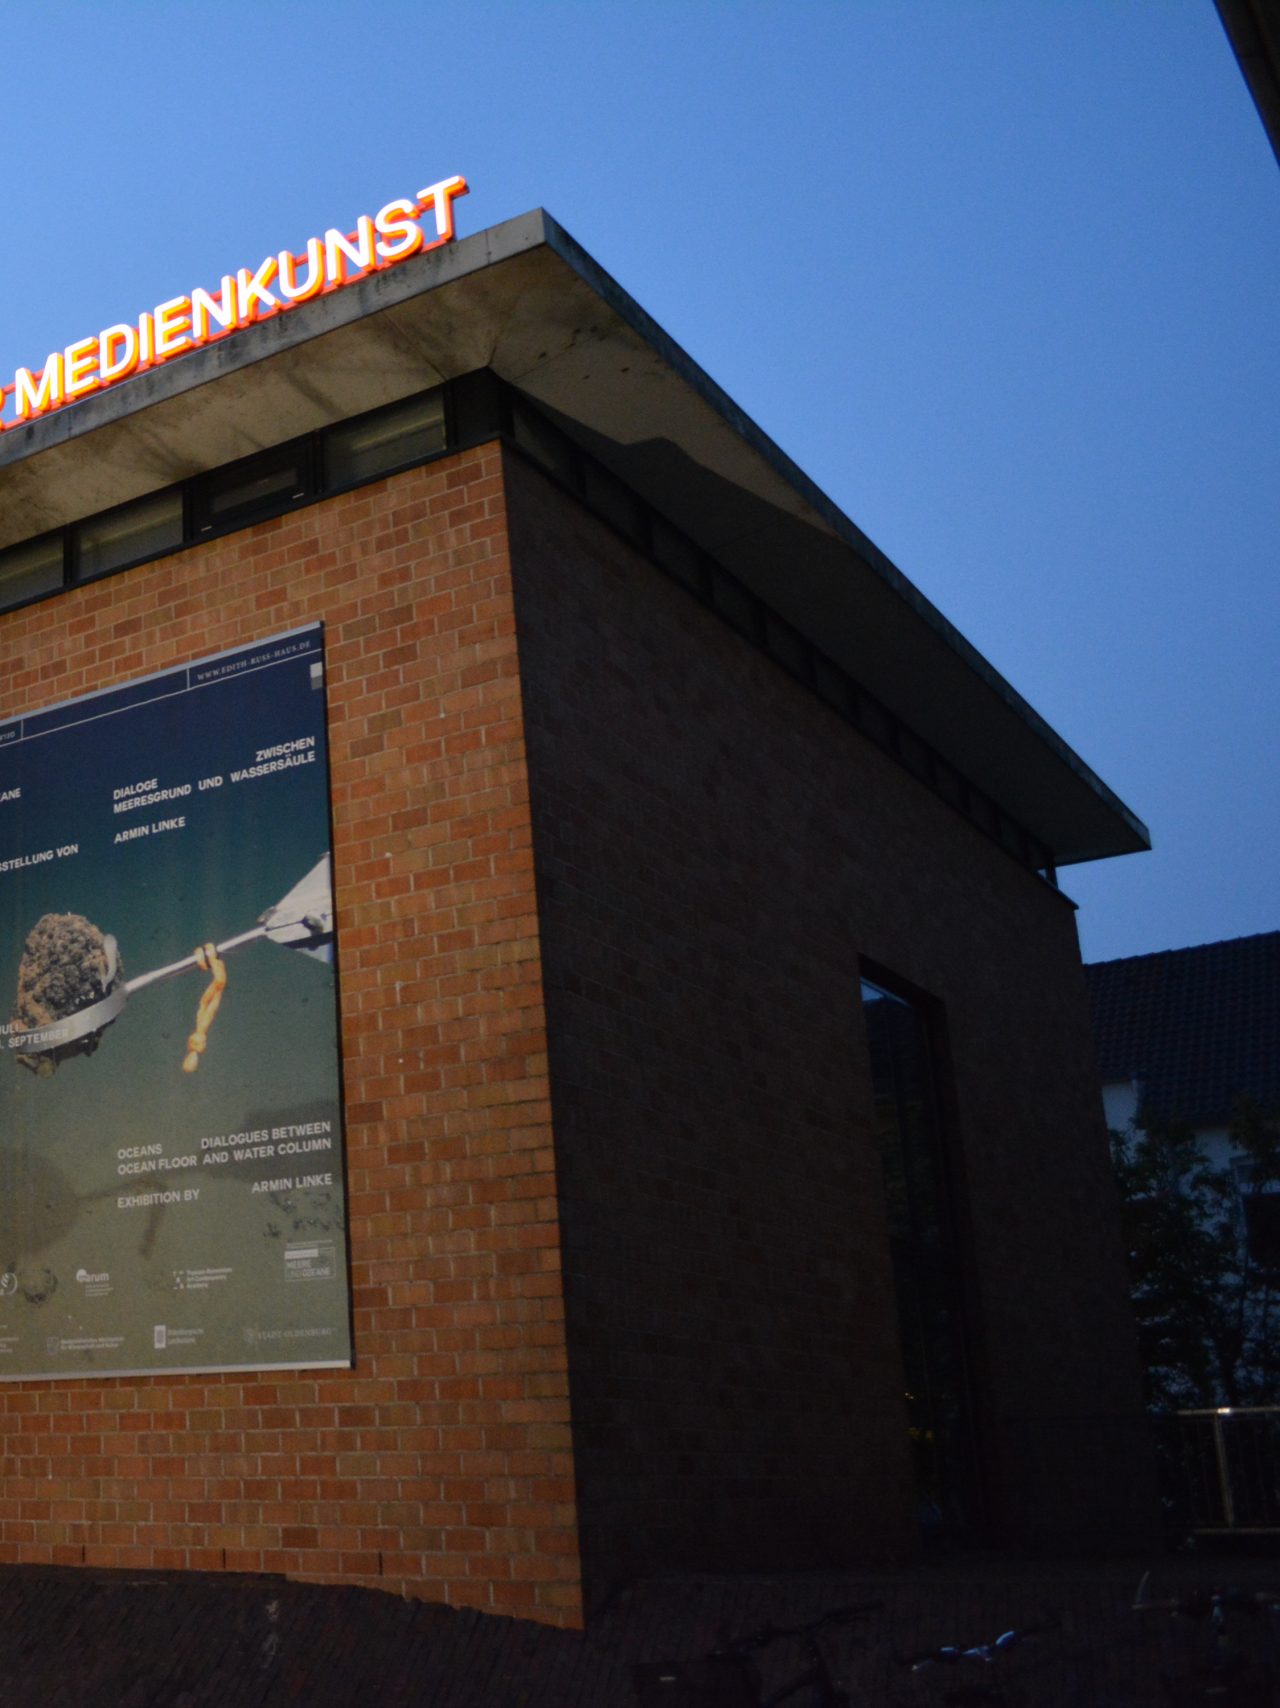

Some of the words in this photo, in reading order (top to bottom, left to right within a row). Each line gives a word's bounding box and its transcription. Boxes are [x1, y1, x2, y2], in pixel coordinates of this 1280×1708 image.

[14, 175, 469, 416] MEDIENKUNST
[255, 736, 316, 762] ZWISCHEN
[113, 784, 192, 814] MEERESGRUND
[198, 775, 224, 791] UND
[230, 750, 316, 783] WASSERSÄULE
[113, 778, 158, 800] DIALOGE
[114, 822, 150, 844] ARMIN
[151, 816, 186, 836] LINKE
[56, 843, 79, 858] VON
[200, 1129, 269, 1150] DIALOGUES
[271, 1120, 331, 1141] BETWEEN
[117, 1143, 163, 1160] OCEANS
[117, 1159, 157, 1176] OCEAN
[158, 1154, 198, 1171] FLOOR
[202, 1150, 229, 1165] AND
[233, 1145, 275, 1162] WATER
[277, 1138, 332, 1156] COLUMN
[251, 1177, 293, 1194] ARMIN
[295, 1173, 333, 1189] LINKE
[117, 1191, 183, 1208] EXHIBITION
[183, 1188, 200, 1201] BY
